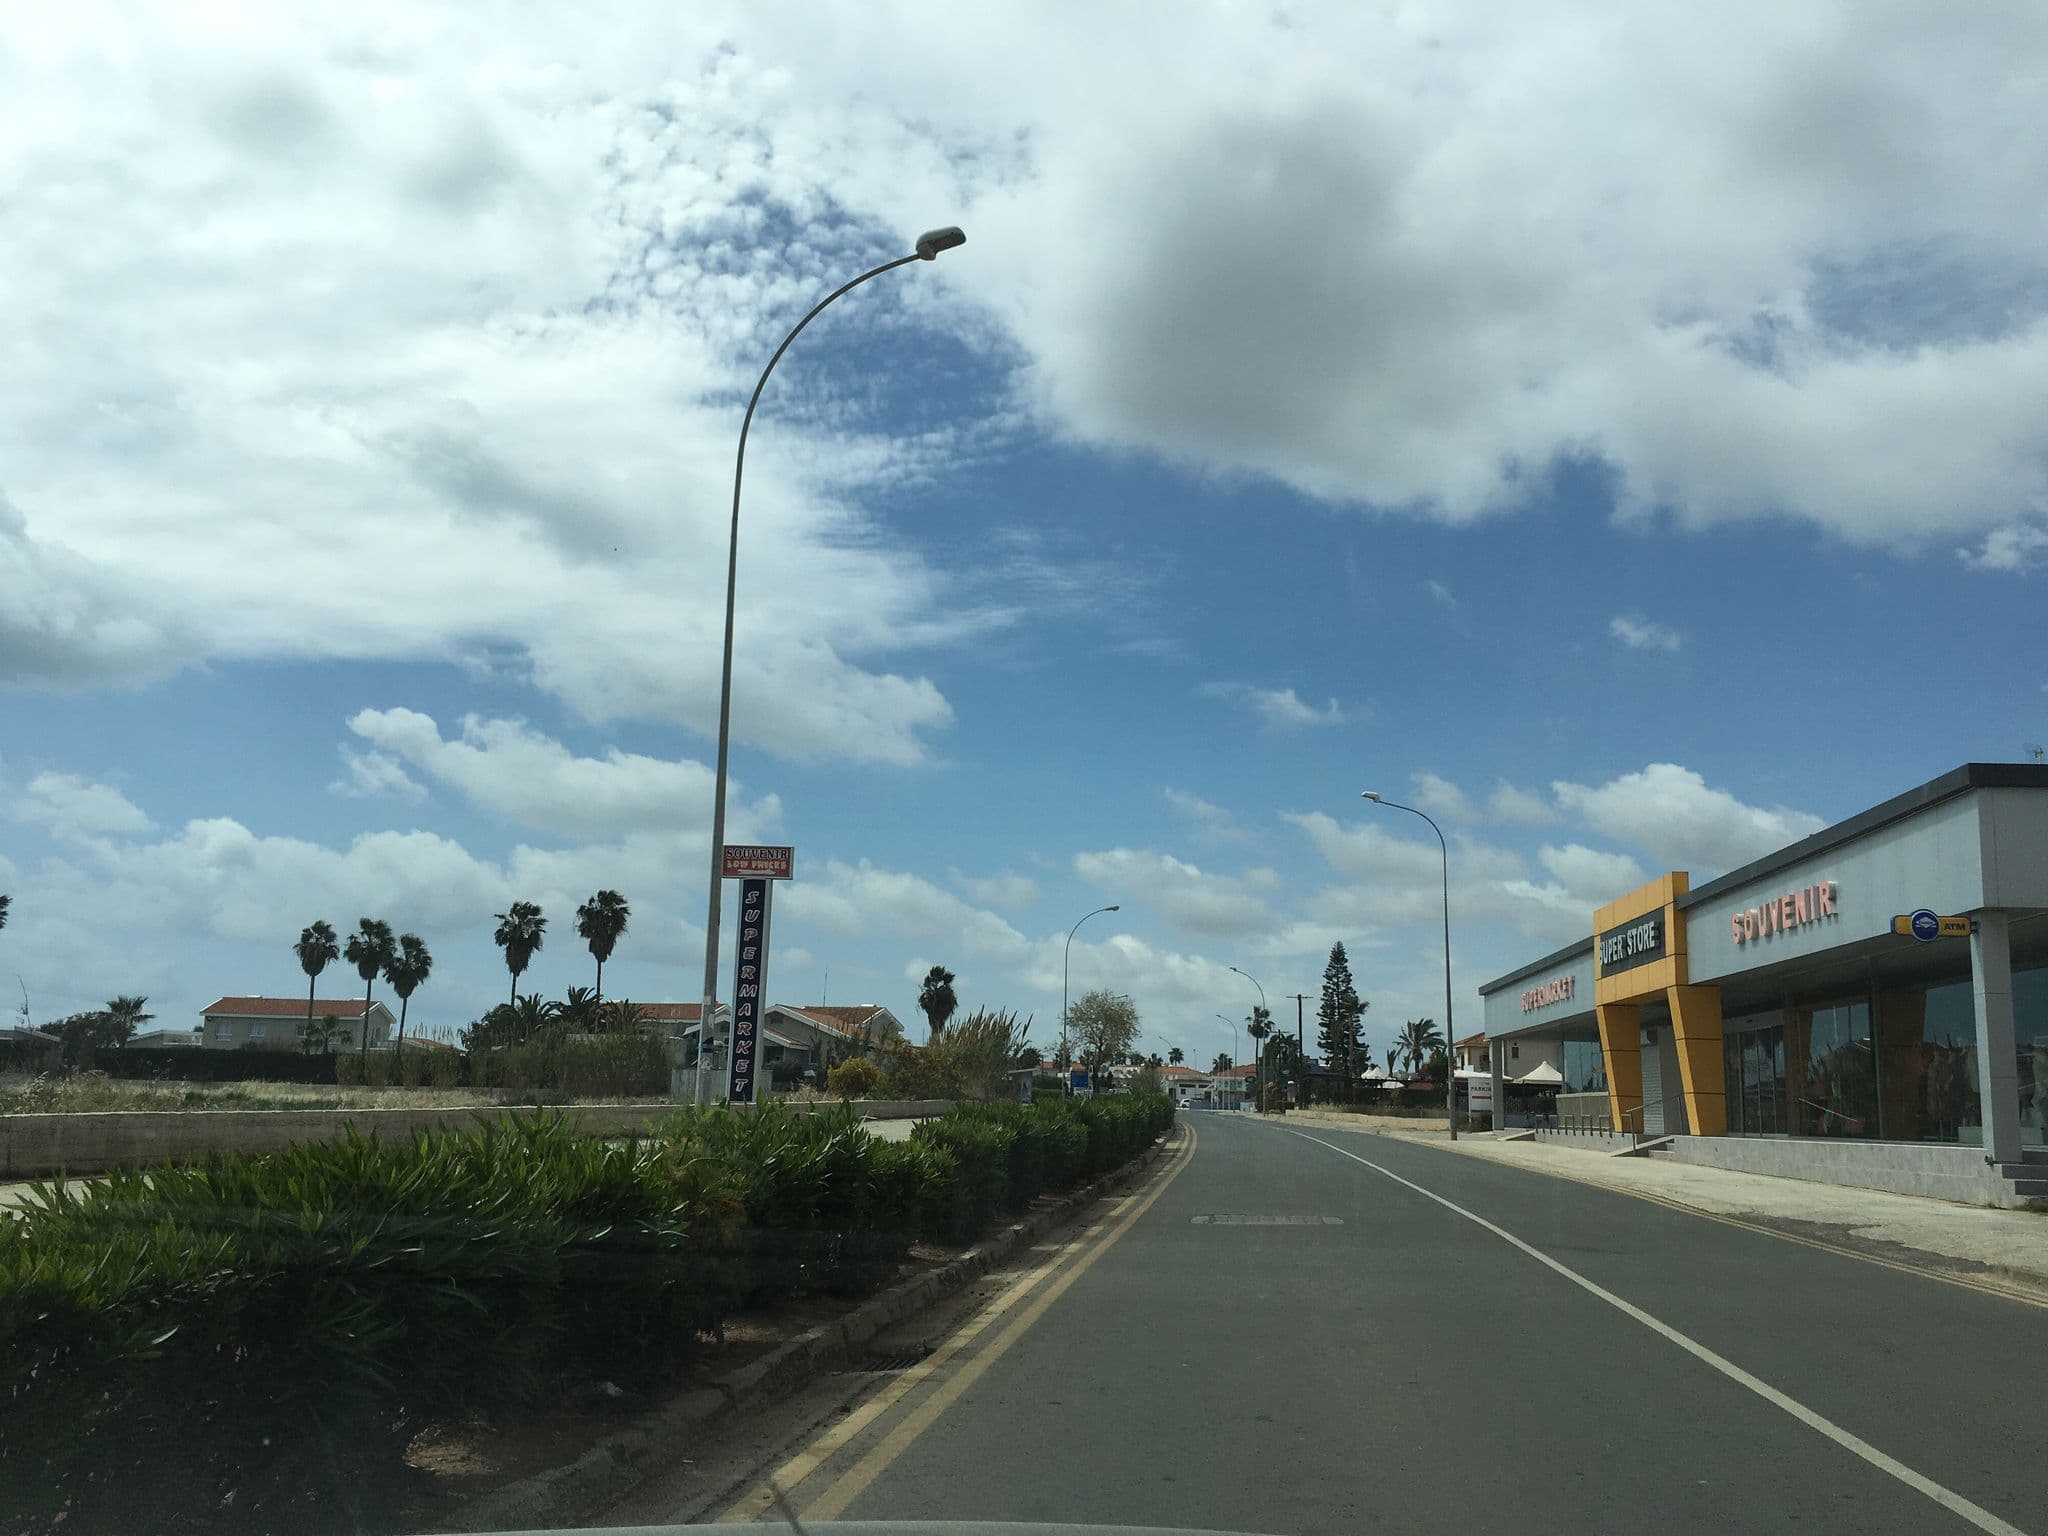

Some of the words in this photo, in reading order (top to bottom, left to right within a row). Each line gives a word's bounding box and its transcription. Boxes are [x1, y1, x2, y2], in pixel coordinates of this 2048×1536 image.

[727, 848, 789, 859] SOUVENIR
[727, 860, 749, 868] LOW
[751, 860, 787, 870] PRICES
[1731, 880, 1836, 943] SOUVENIR
[1600, 934, 1625, 965] SUPER
[1627, 921, 1655, 955] STORE
[735, 891, 760, 1092] SUPERMARKET
[1520, 976, 1575, 1011] SUPERMARKET
